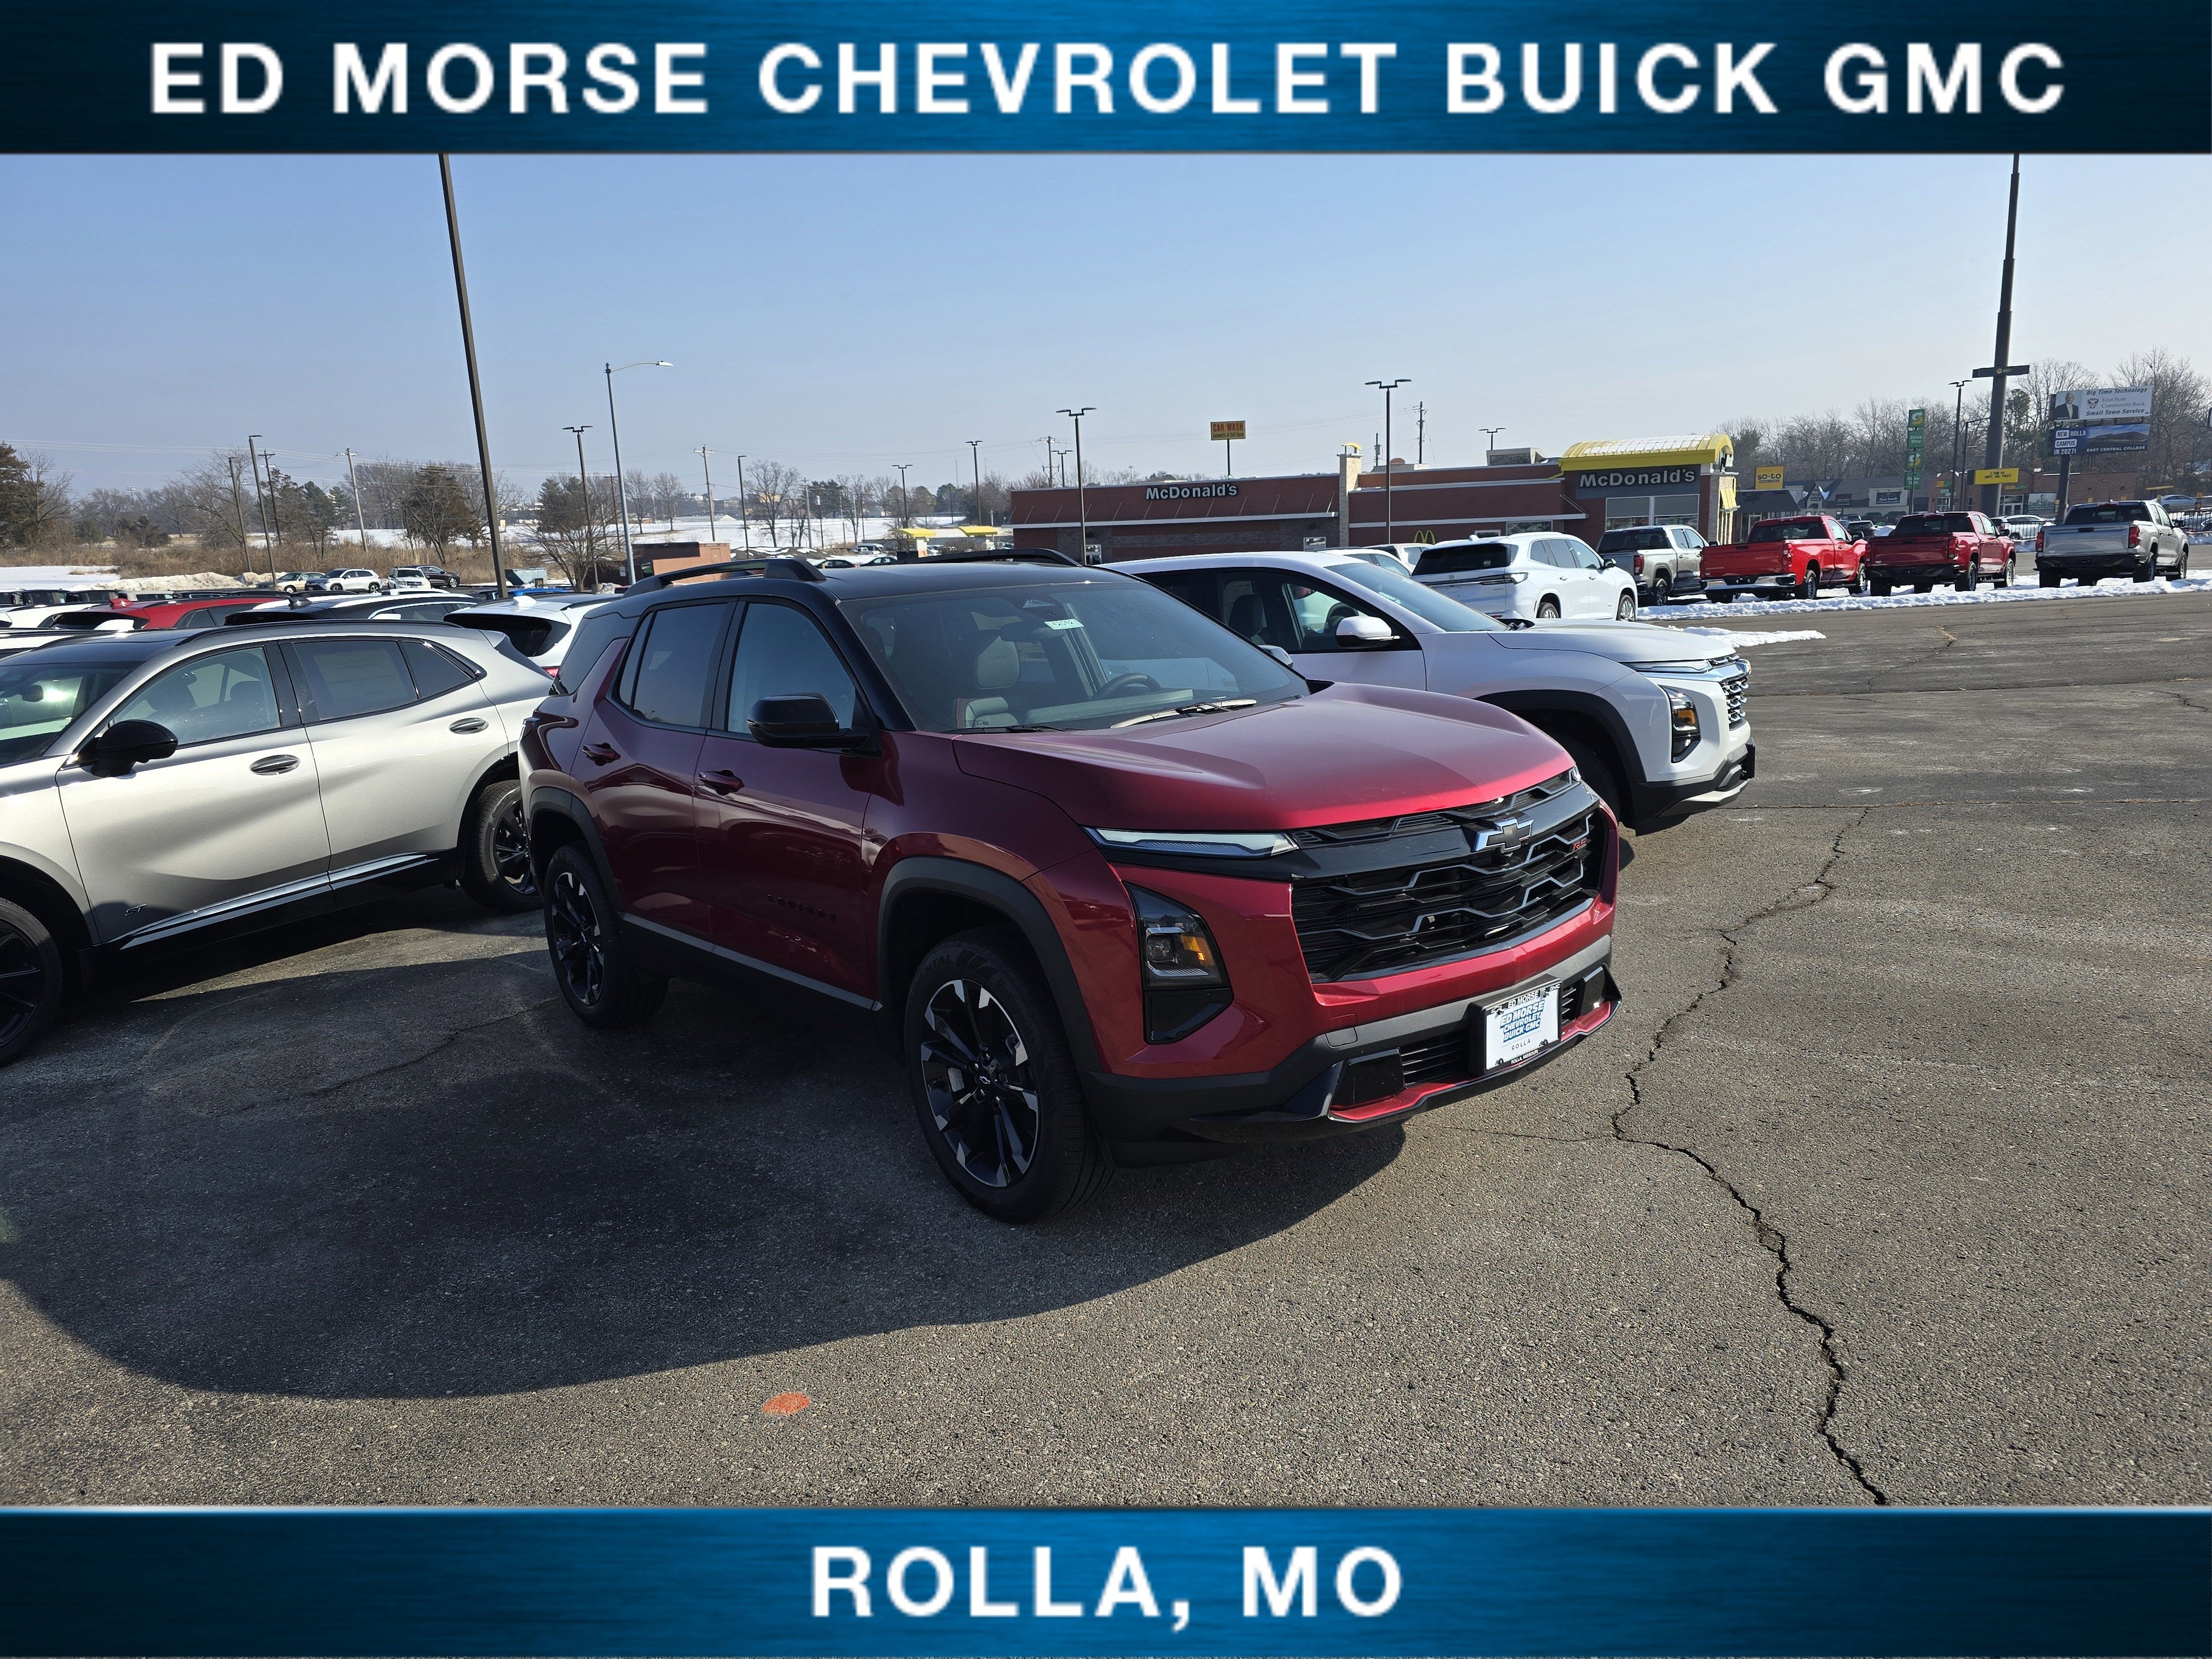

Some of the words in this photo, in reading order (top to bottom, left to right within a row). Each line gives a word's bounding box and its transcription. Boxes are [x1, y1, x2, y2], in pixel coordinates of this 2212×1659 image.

[1213, 423, 1224, 432] CAR
[1227, 422, 1243, 431] WASH
[1579, 468, 1695, 488] McDonald's
[1146, 483, 1238, 500] McDonald's
[124, 903, 147, 917] ST
[1507, 1000, 1516, 1009] ED
[1517, 991, 1539, 1005] MORSE
[1501, 1012, 1514, 1027] ED
[1513, 1000, 1545, 1023] MORSE
[1503, 1013, 1541, 1034] CHEVROLET
[1511, 1039, 1531, 1051] ROLLA
[1522, 1049, 1539, 1061] MISSOURI
